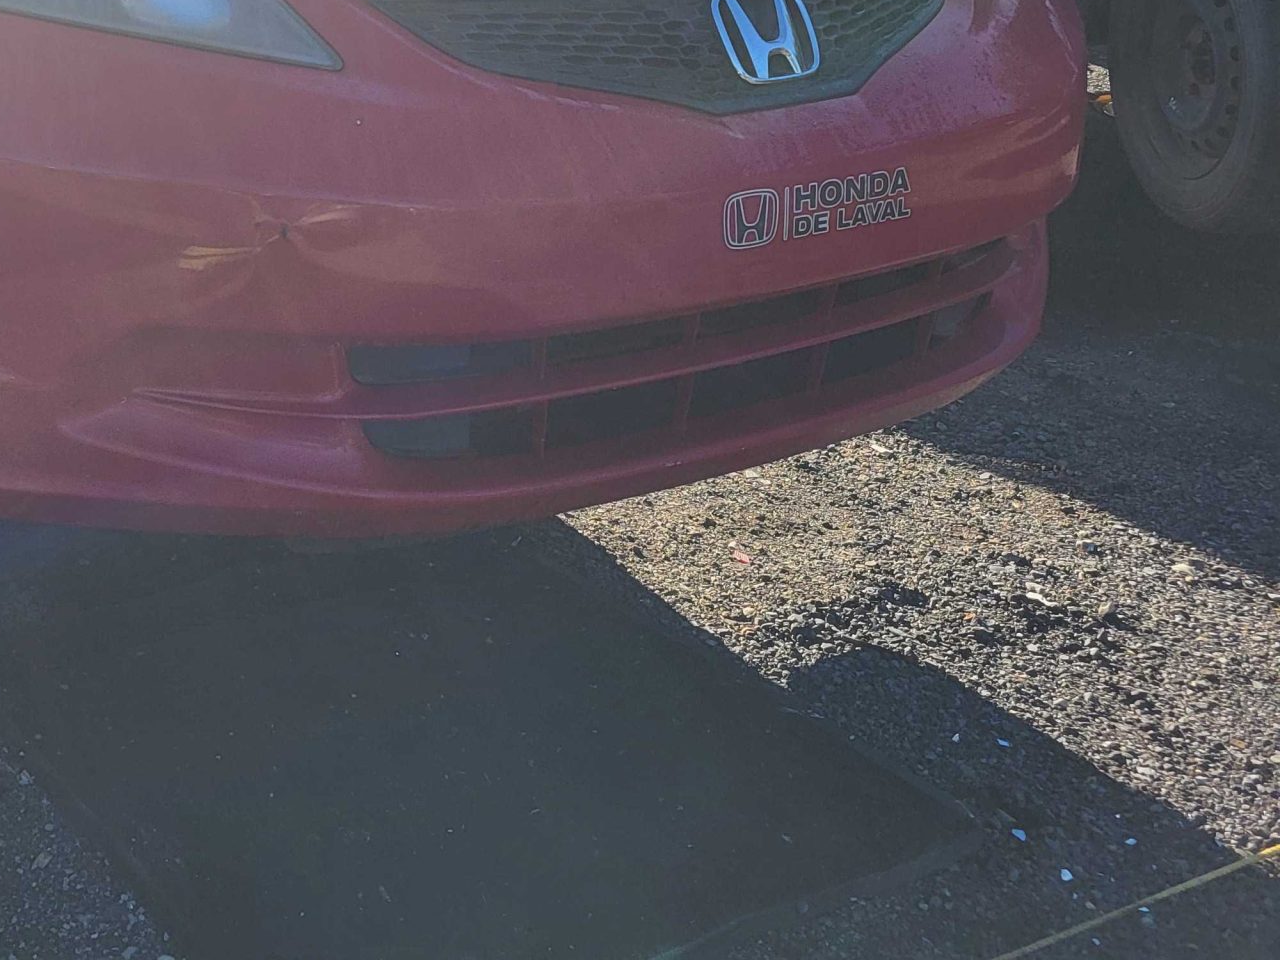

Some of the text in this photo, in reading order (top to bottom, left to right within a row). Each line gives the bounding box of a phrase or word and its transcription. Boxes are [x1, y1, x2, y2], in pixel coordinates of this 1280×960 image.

[793, 167, 910, 213] HONDA
[793, 197, 911, 238] DE LAVAL
